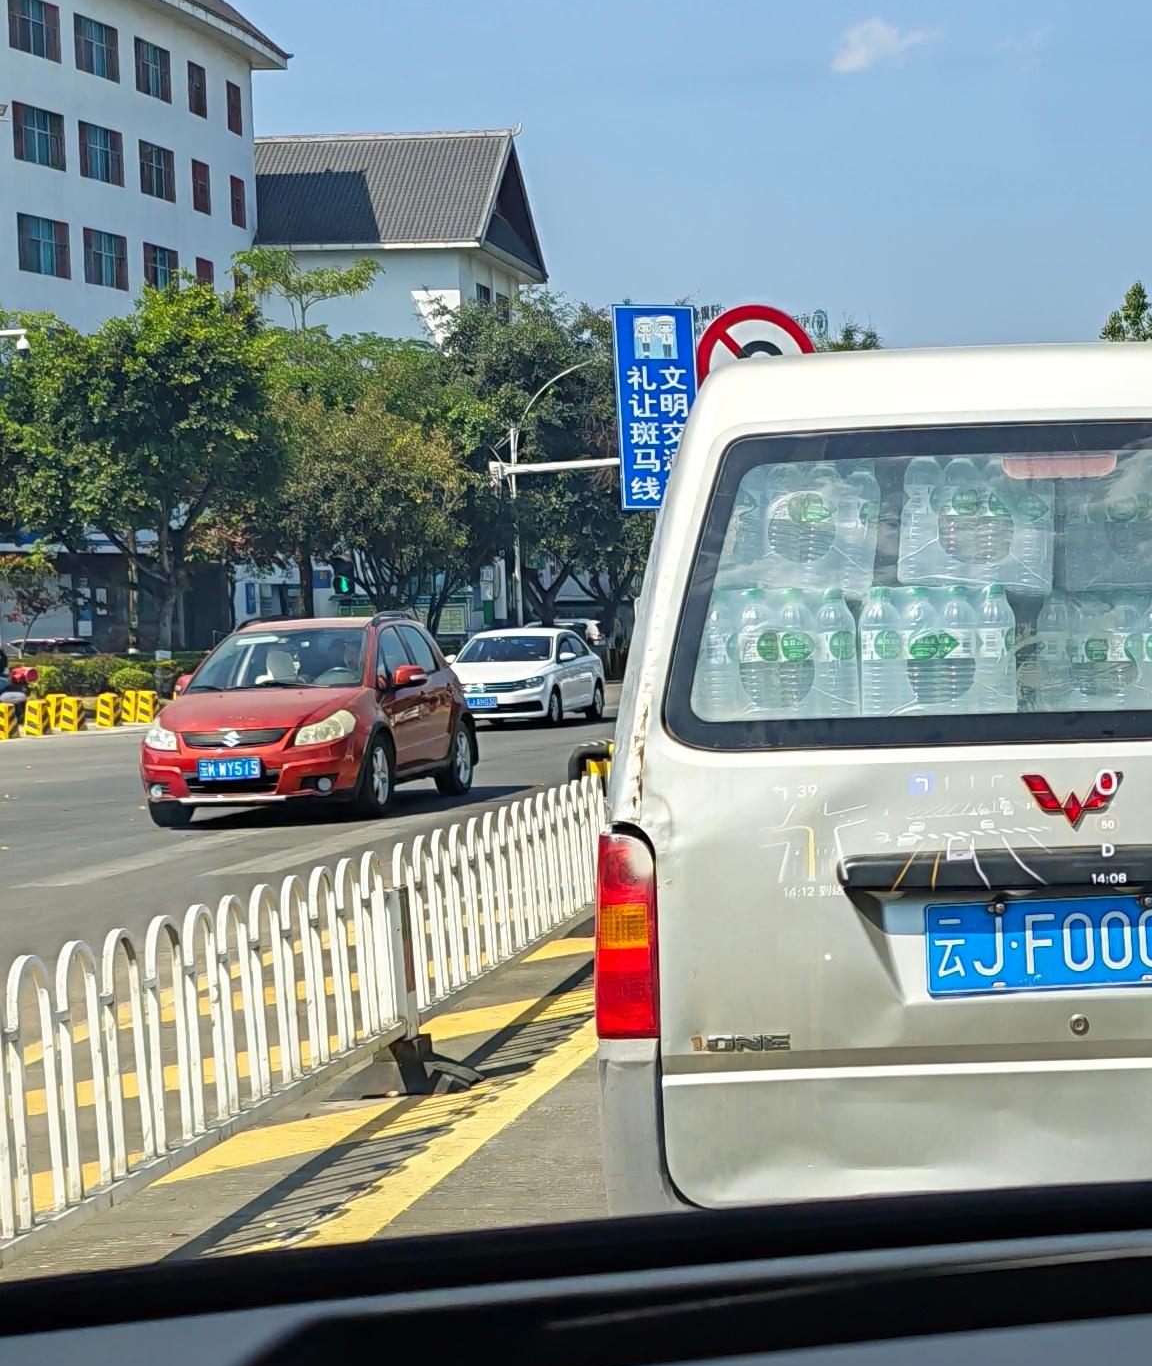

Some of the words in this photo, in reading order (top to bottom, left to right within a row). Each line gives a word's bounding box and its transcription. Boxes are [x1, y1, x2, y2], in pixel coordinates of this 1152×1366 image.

[626, 366, 661, 501] 礼让斑马线
[796, 785, 818, 798] 39
[1101, 819, 1115, 830] 50
[1102, 843, 1115, 857] D
[1091, 872, 1127, 884] 14:08
[783, 885, 815, 898] 14:12
